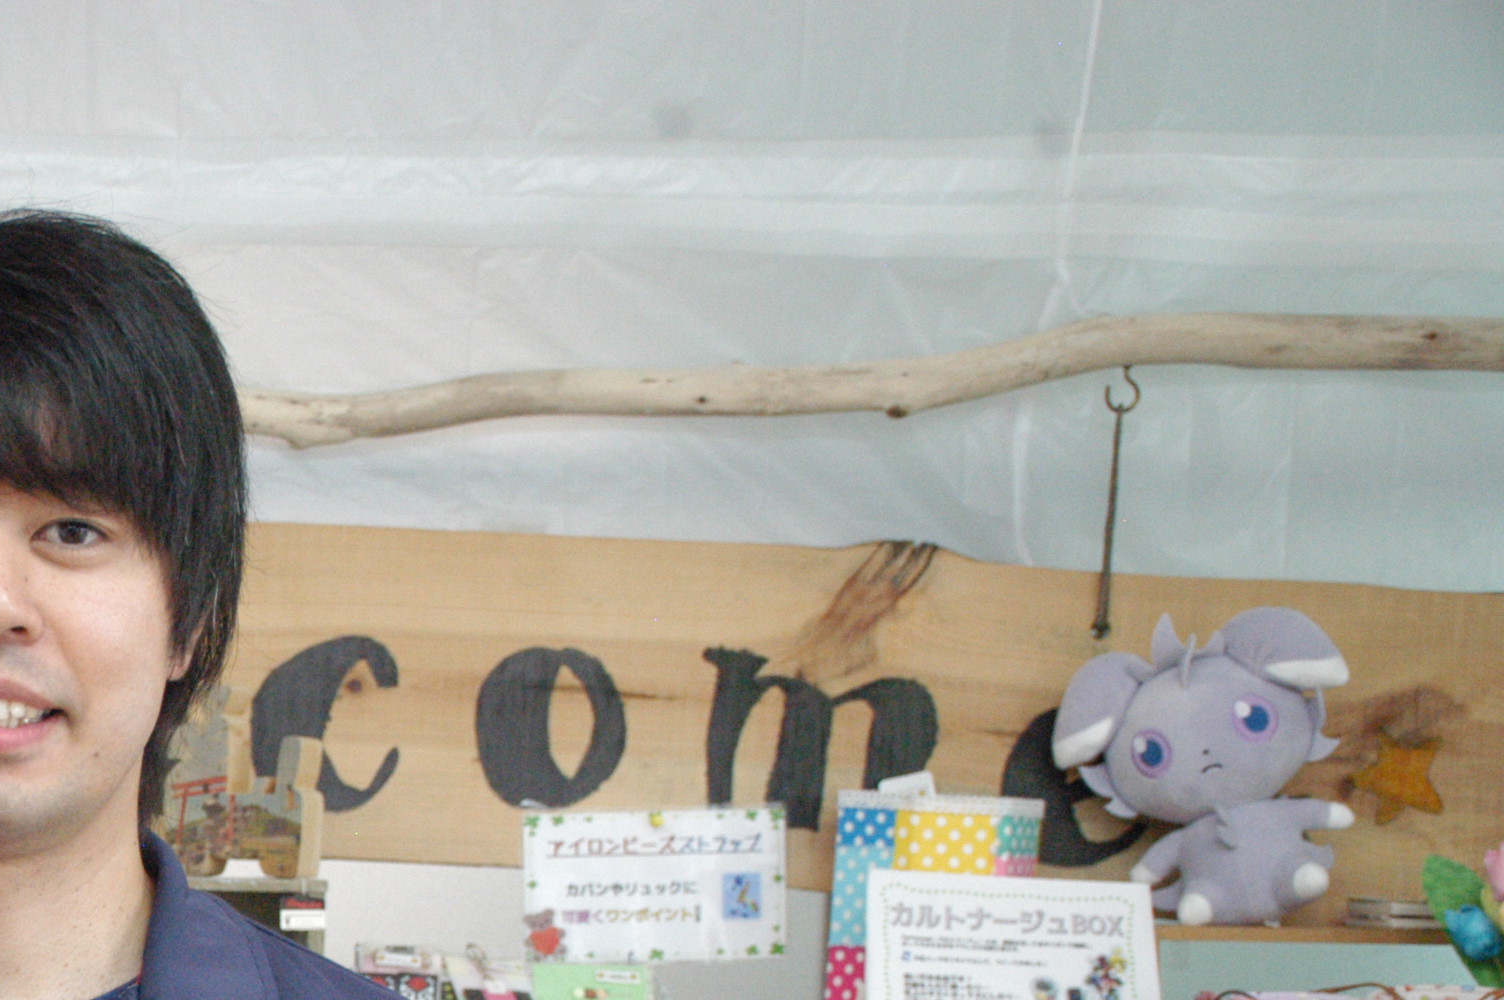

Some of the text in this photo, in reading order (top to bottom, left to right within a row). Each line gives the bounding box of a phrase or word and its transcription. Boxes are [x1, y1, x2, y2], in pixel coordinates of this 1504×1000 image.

[890, 902, 1125, 938] カルトナージュBOX
